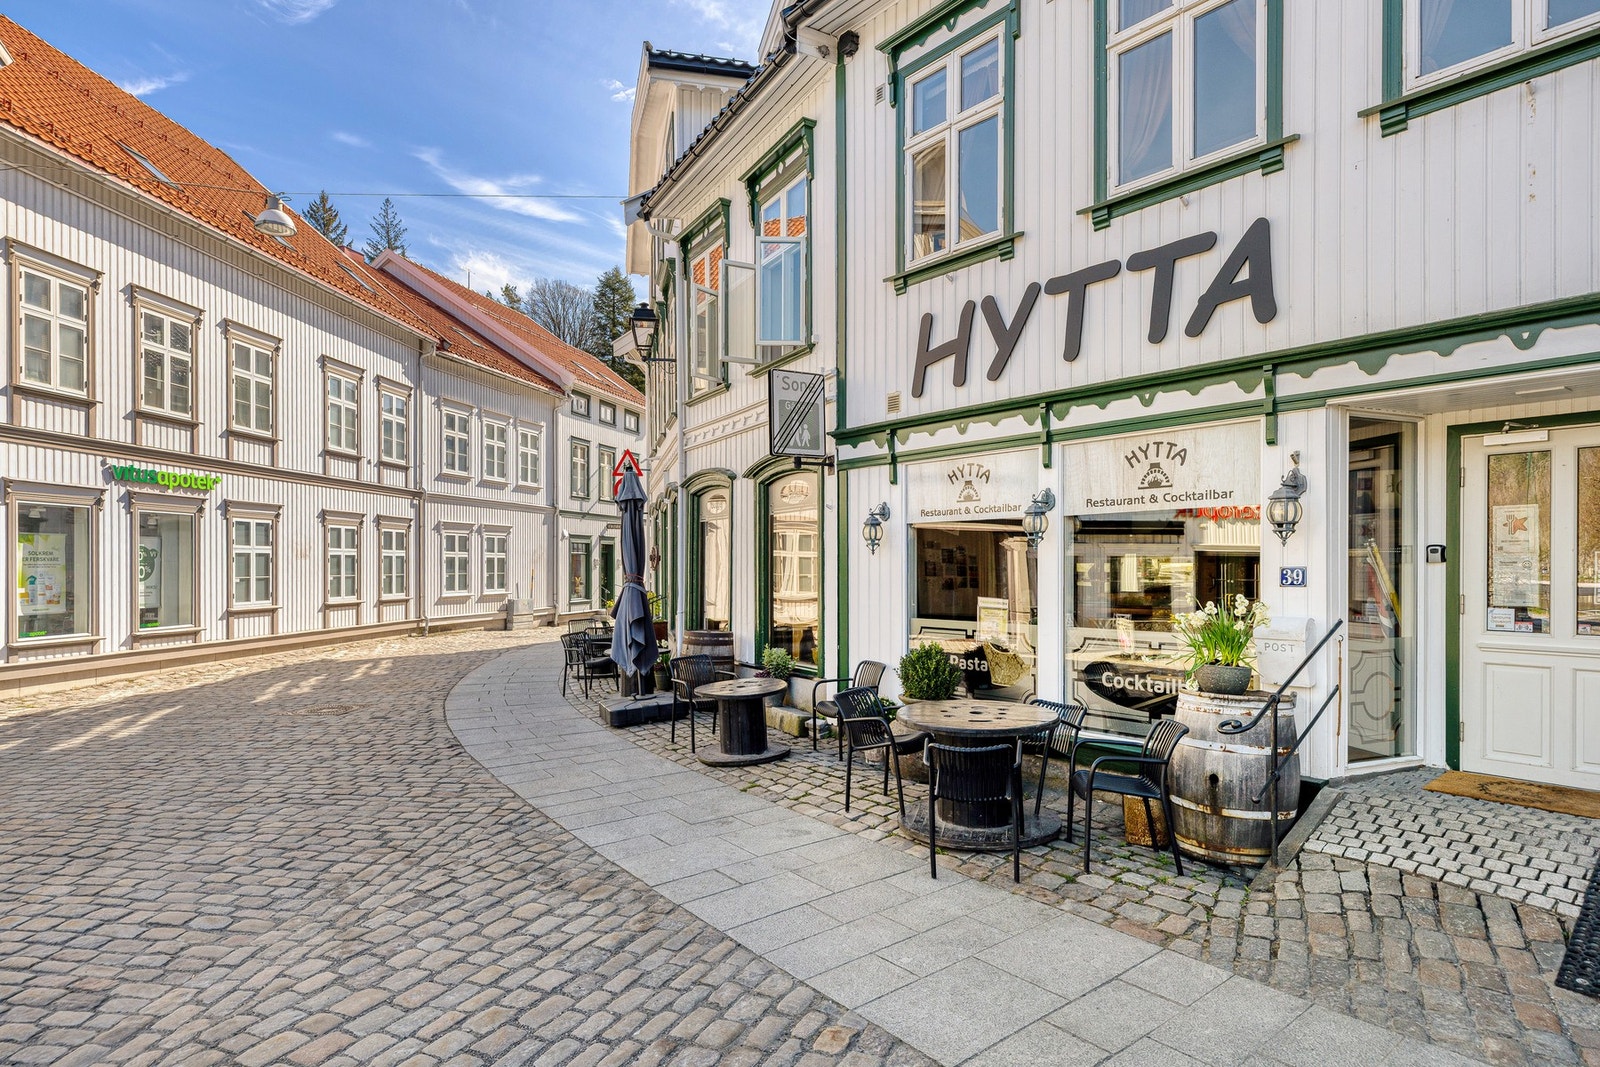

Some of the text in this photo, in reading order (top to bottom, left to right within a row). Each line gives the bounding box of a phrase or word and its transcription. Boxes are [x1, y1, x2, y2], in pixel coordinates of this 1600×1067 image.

[911, 217, 1277, 398] HYTTA
[1124, 441, 1187, 468] HYTTA
[947, 463, 991, 485] HYTTA
[1086, 489, 1234, 508] Restaurant & Cocktailbar
[920, 503, 1022, 517] Restaurant & Cocktailbar
[1282, 568, 1303, 585] 39
[1264, 642, 1295, 653] POST
